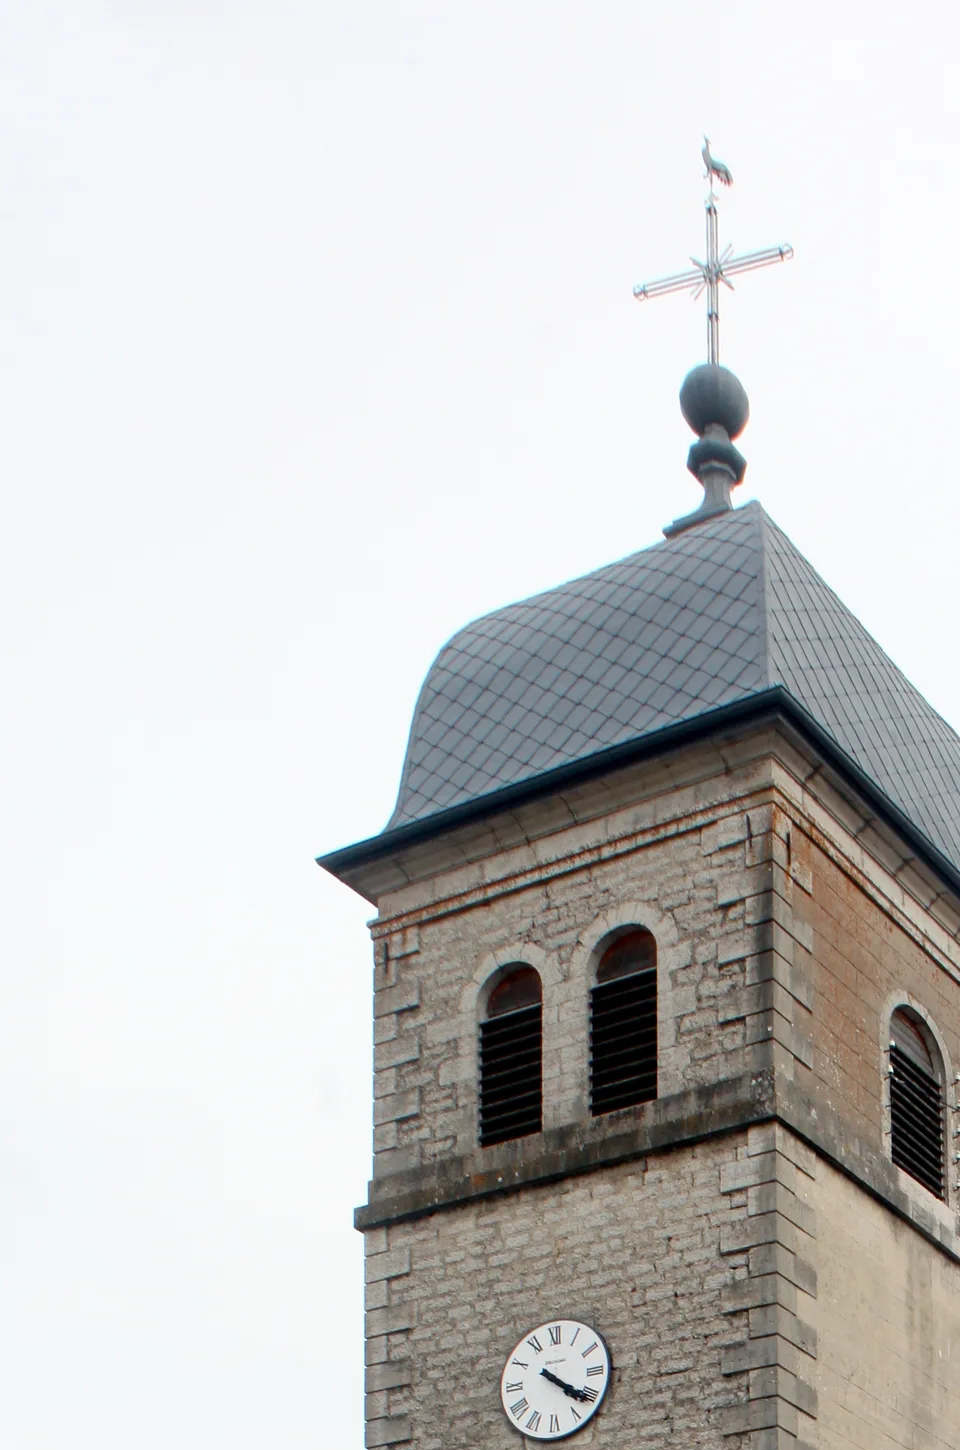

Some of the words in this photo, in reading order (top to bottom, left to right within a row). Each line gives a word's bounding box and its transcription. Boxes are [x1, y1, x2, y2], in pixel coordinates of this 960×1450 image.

[527, 1335, 544, 1355] XI
[548, 1325, 561, 1346] XII
[570, 1327, 581, 1347] I
[581, 1341, 599, 1358] II
[512, 1357, 529, 1370] X
[586, 1364, 604, 1377] III
[506, 1381, 524, 1393] IX
[510, 1397, 530, 1421] VIII
[570, 1406, 582, 1423] V
[525, 1410, 542, 1432] VII
[549, 1414, 560, 1433] VI
